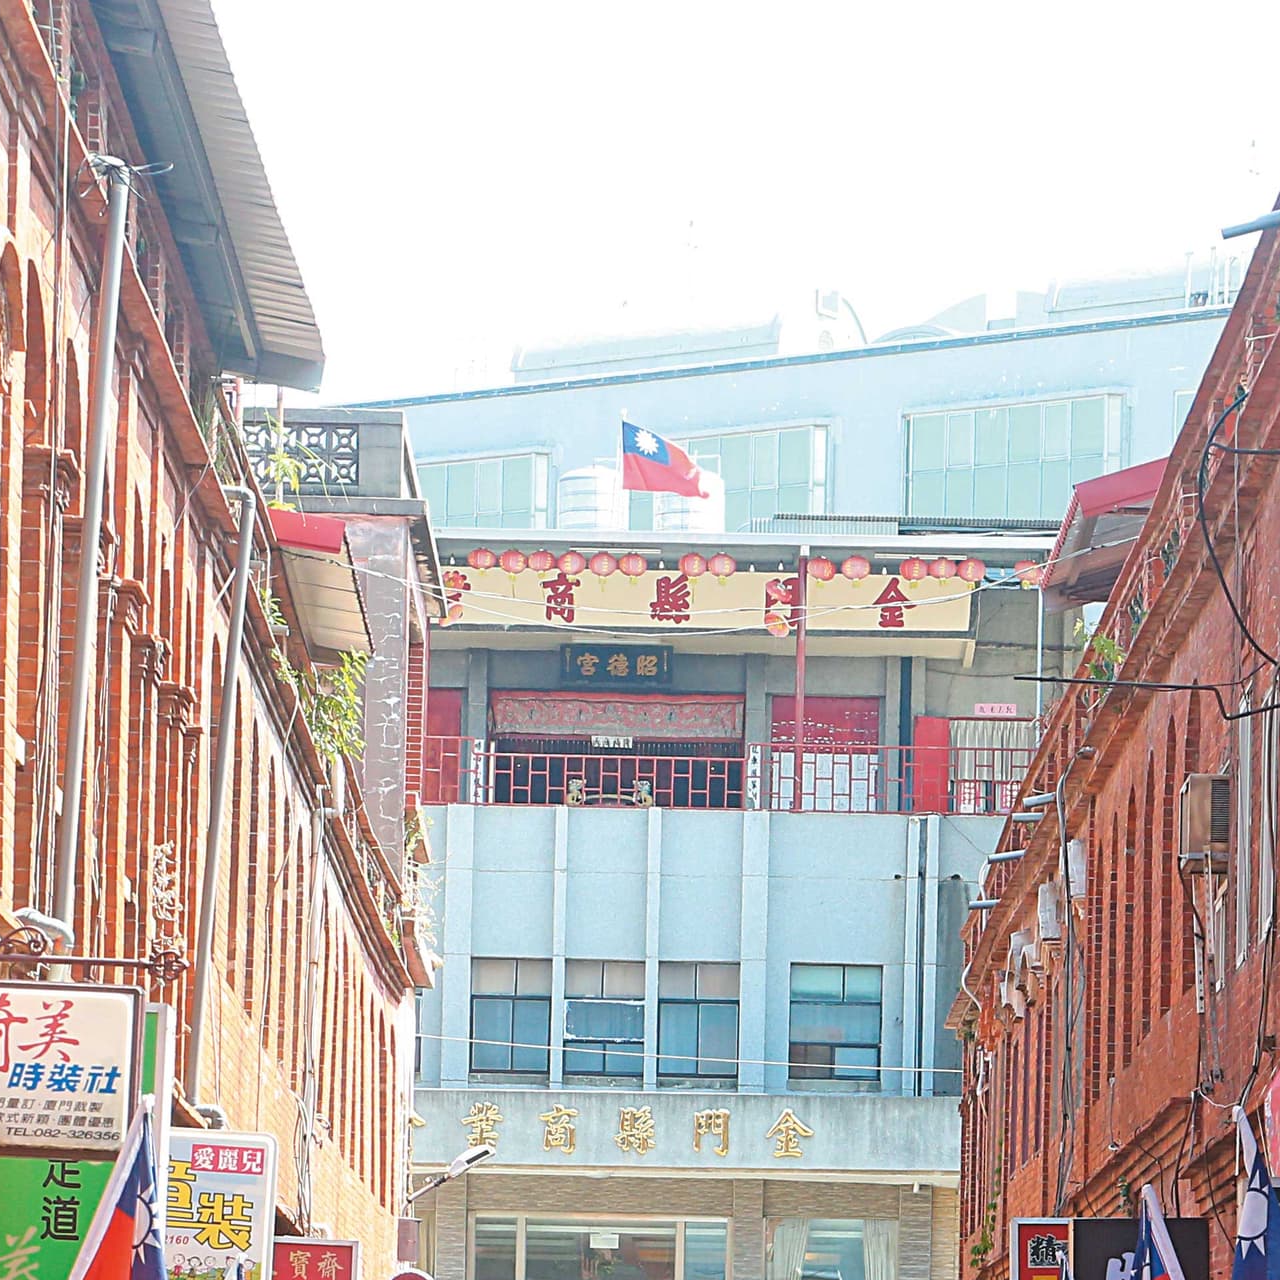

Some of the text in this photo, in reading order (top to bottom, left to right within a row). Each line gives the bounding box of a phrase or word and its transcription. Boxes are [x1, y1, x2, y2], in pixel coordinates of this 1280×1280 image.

[442, 571, 915, 629] 金門縣商
[410, 1101, 815, 1159] 金門縣商業
[193, 1147, 263, 1173] 愛麗兒
